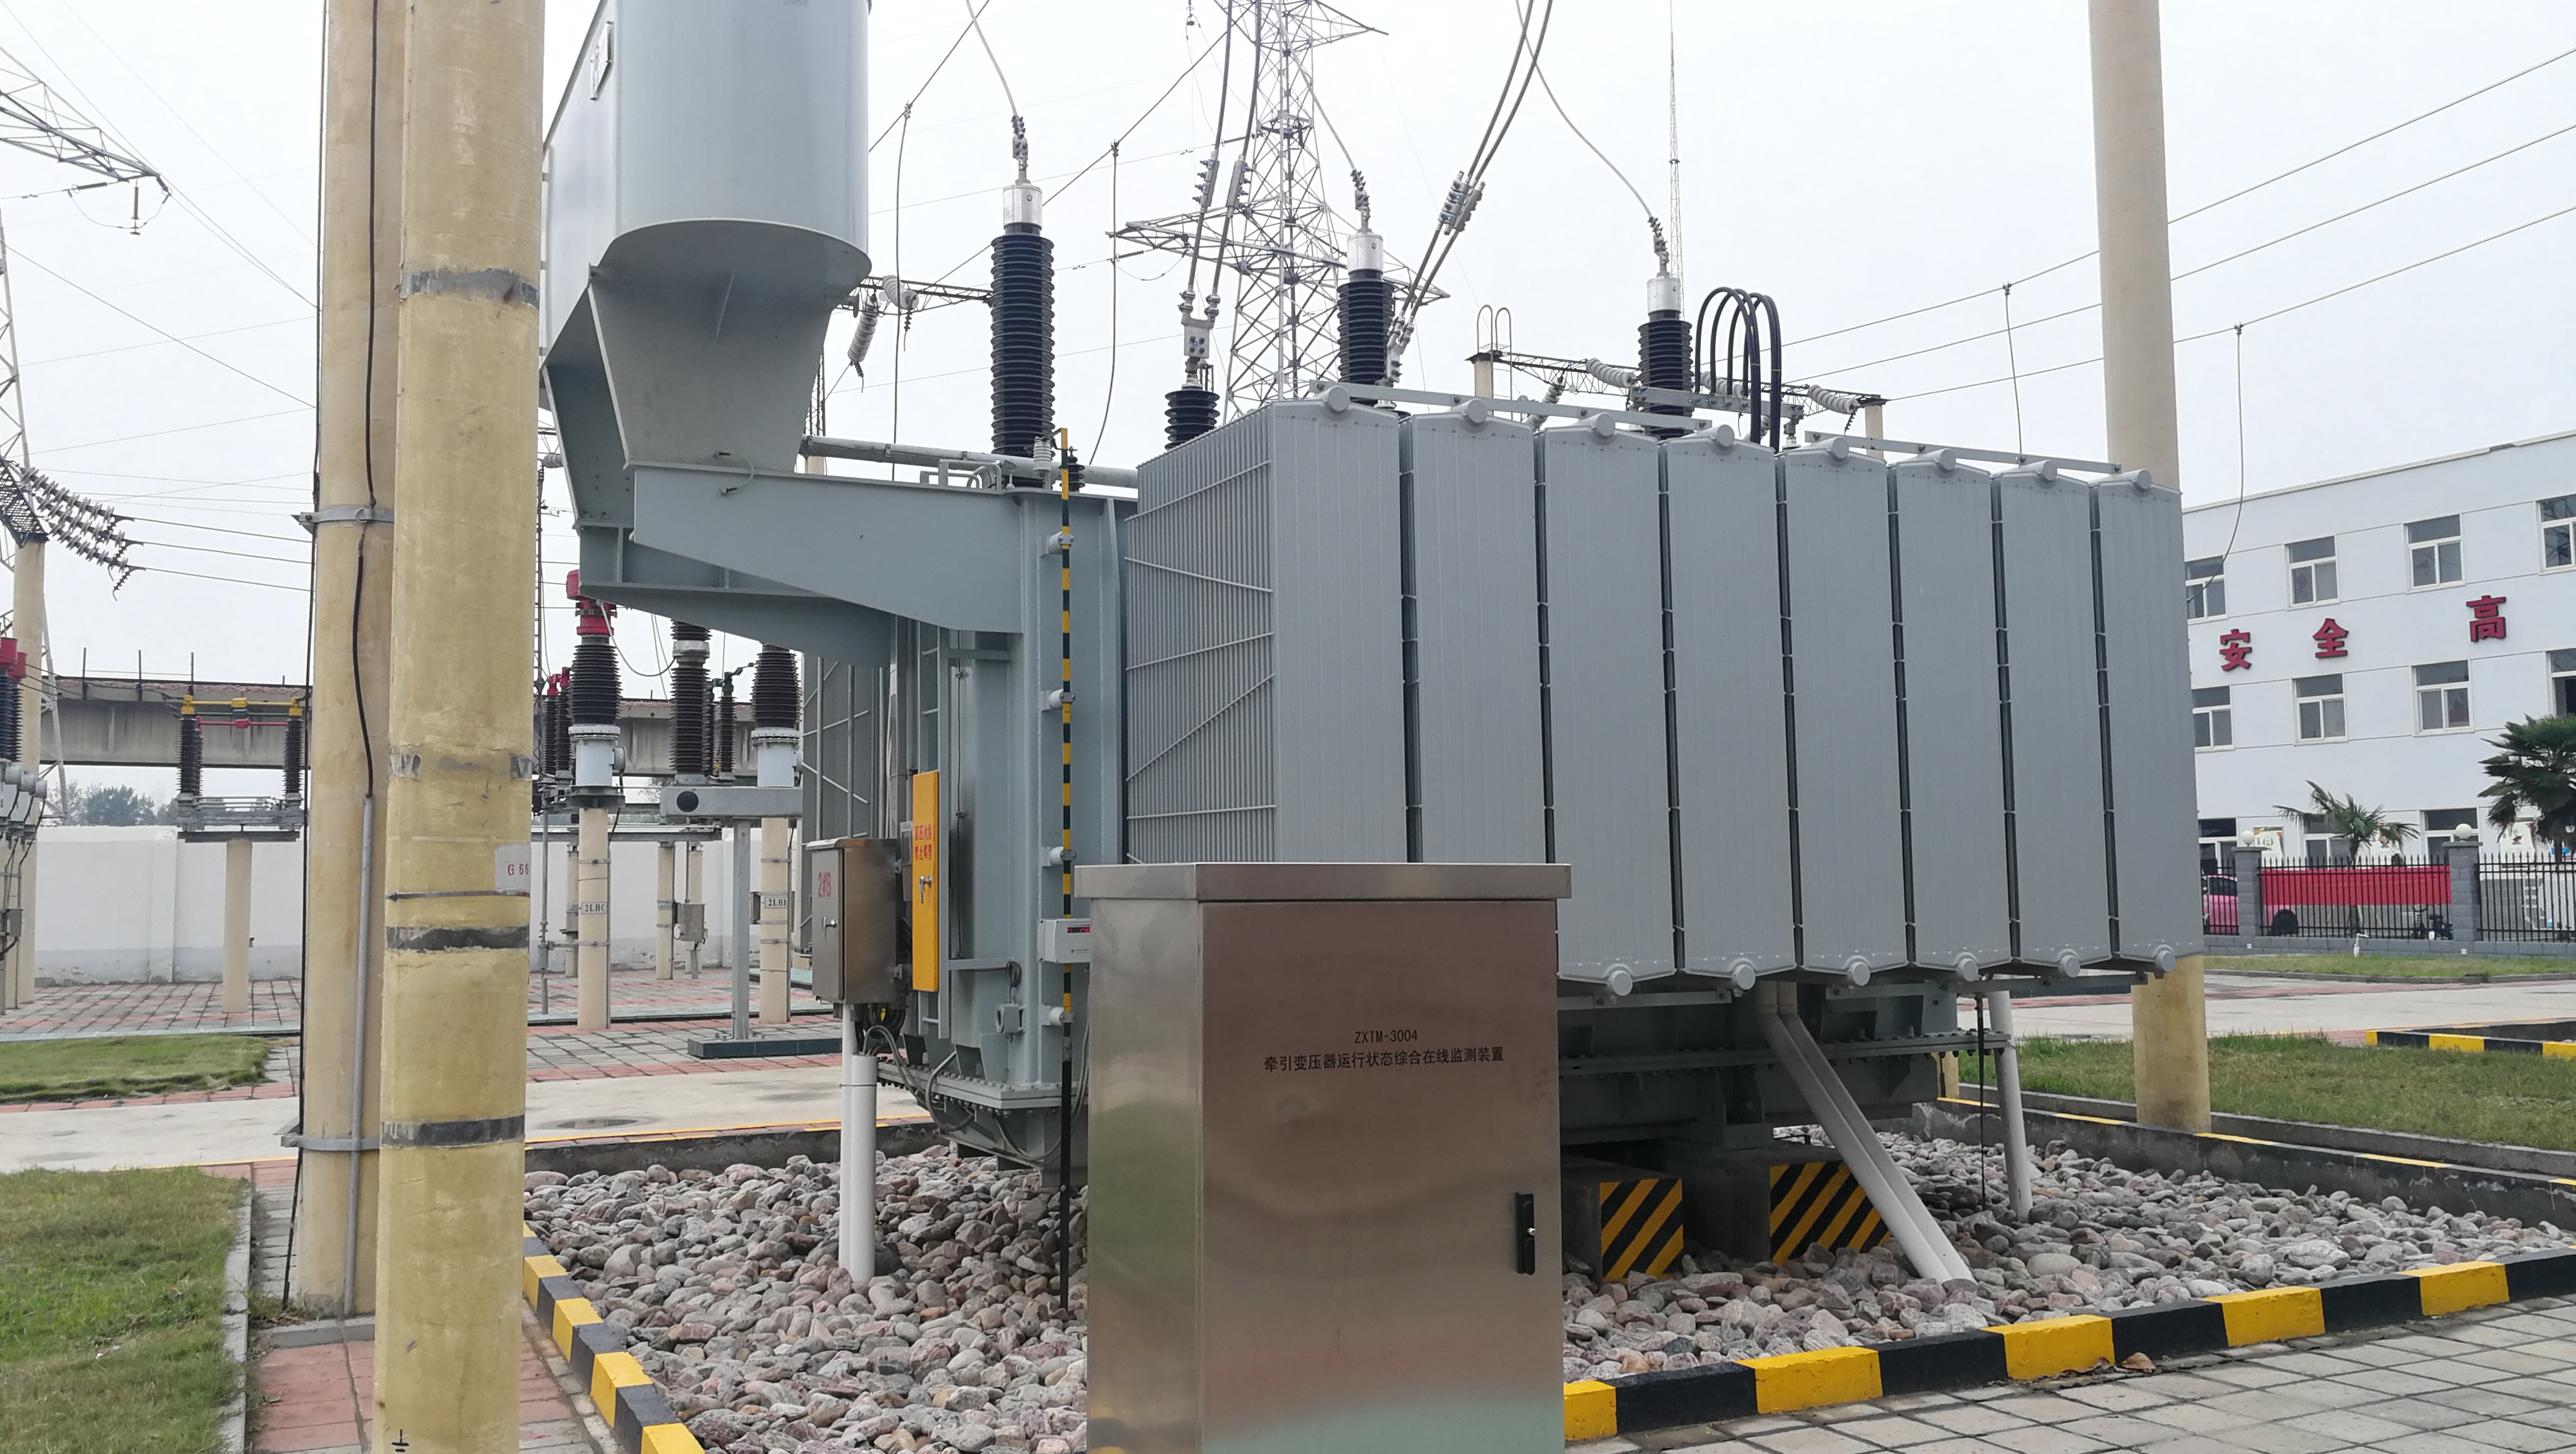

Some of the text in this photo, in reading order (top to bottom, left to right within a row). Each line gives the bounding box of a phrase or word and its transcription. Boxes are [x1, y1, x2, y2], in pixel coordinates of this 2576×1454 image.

[2465, 595, 2507, 643] 高
[817, 871, 832, 898] 2#B
[584, 904, 606, 913] 2LHC
[1354, 1029, 1418, 1044] ZXTM-3004
[1263, 1046, 1505, 1073] 牵引变压器运行状态综合在线监测装置
